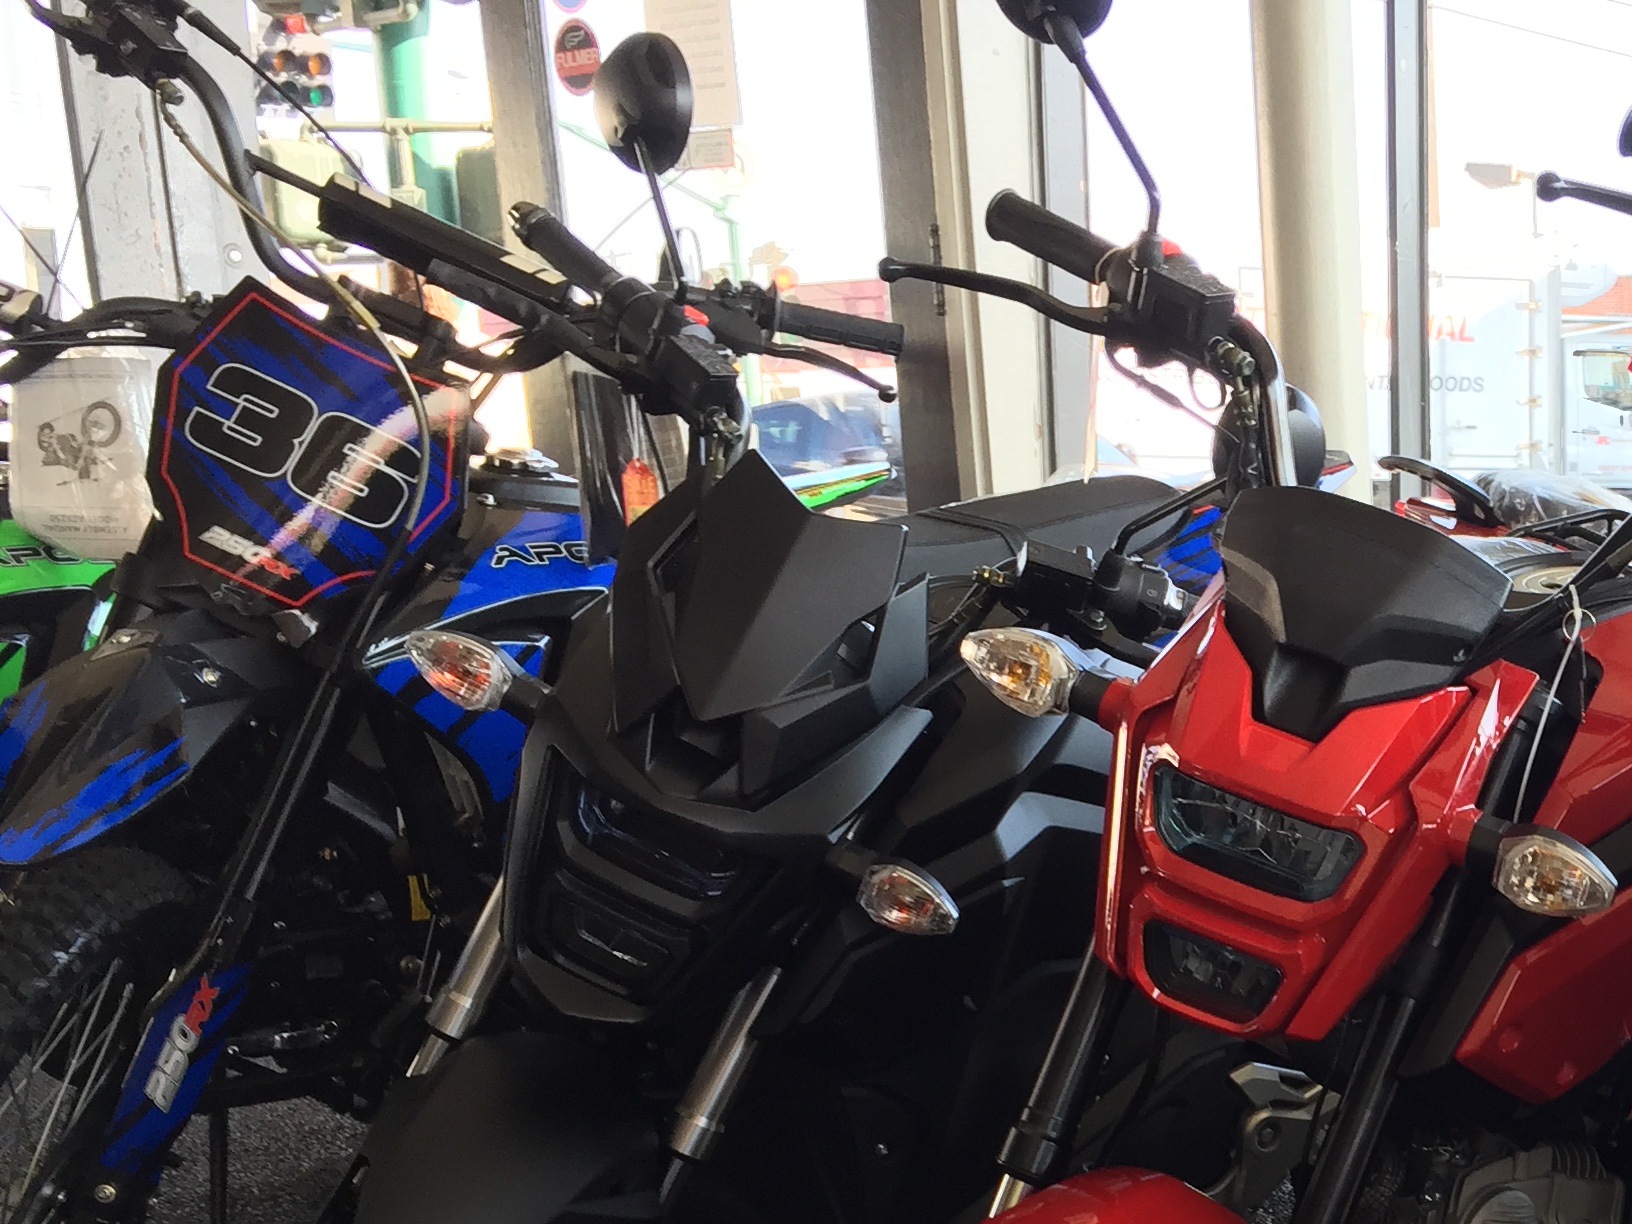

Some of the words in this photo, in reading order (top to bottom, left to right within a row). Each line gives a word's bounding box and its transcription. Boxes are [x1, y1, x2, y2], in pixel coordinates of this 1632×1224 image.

[1430, 375, 1485, 393] OODS
[184, 362, 422, 529] 36
[198, 524, 300, 581] 250RX
[143, 973, 220, 1114] 250RX
